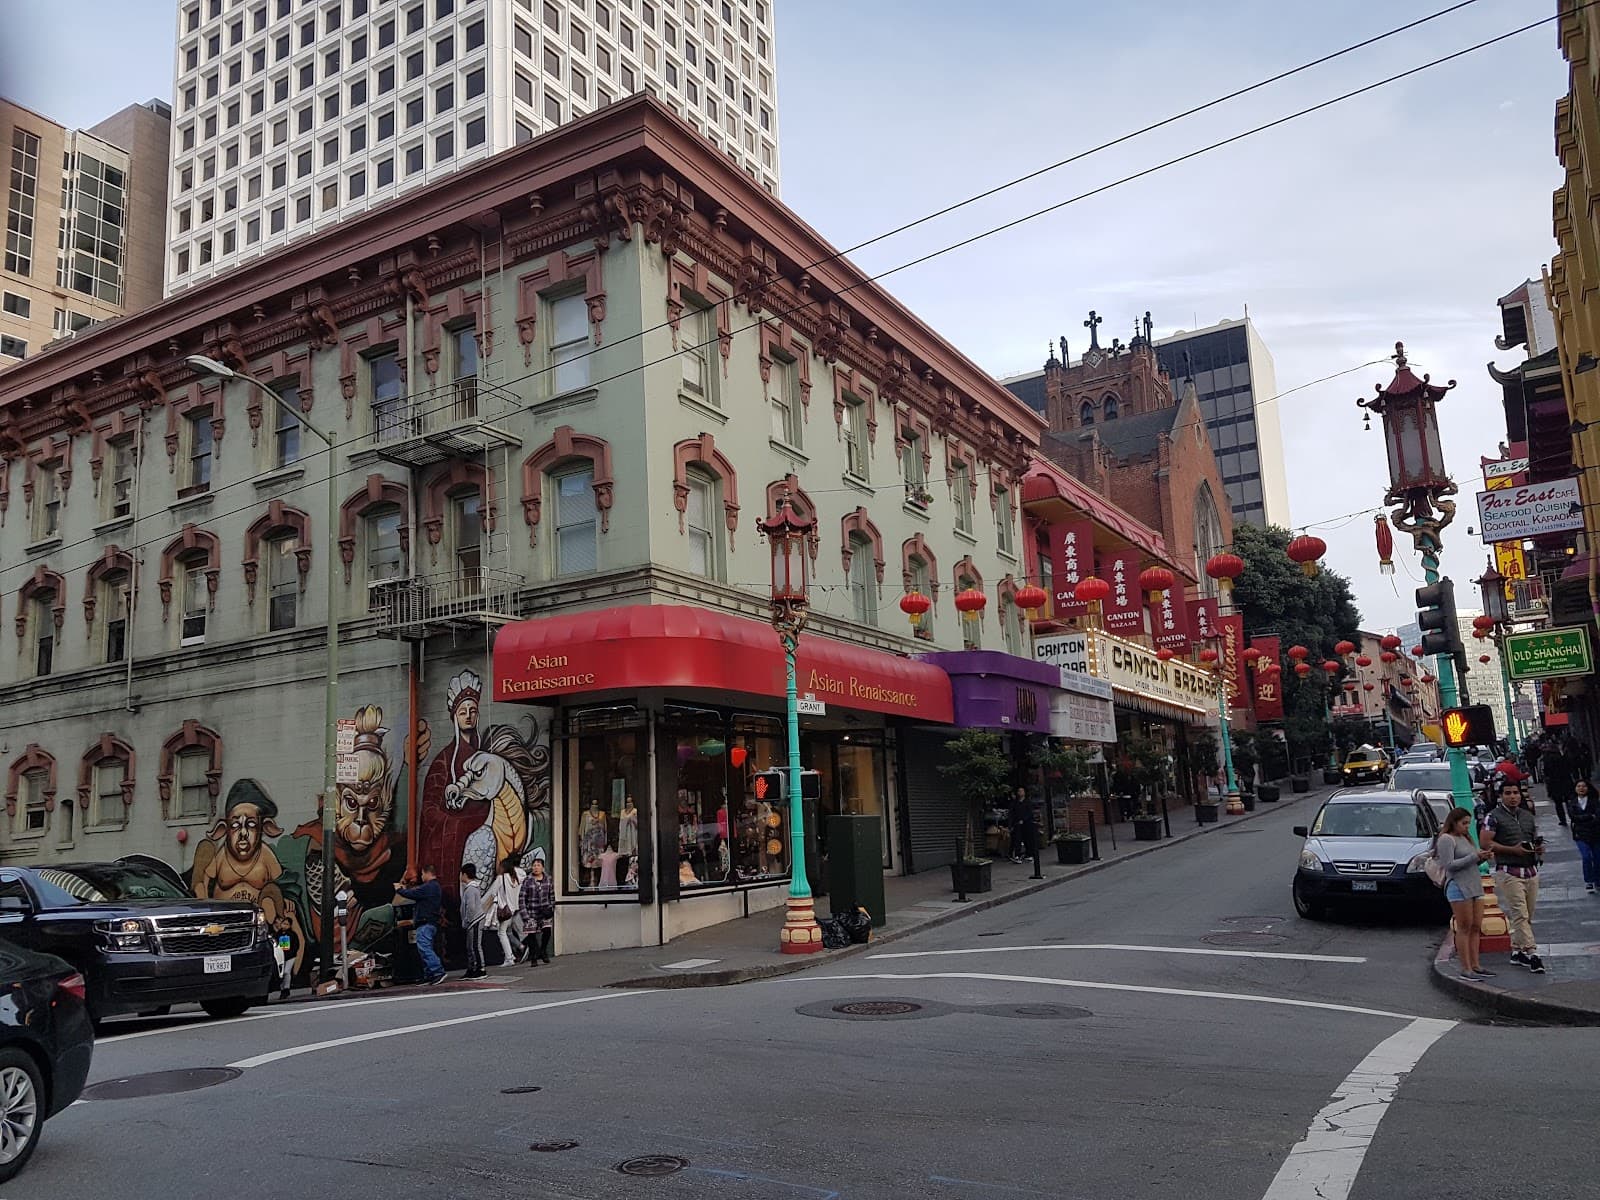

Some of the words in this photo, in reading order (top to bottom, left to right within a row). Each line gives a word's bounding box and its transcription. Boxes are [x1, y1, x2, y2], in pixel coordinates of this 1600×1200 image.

[1481, 493, 1512, 512] Far
[1514, 487, 1555, 507] East
[1107, 611, 1140, 621] CANTON
[1110, 620, 1137, 629] BAZAAR
[1156, 634, 1187, 643] CANTON
[1037, 639, 1085, 657] CANTON
[1513, 650, 1532, 662] OLD
[1533, 644, 1583, 660] SHANGHAI
[527, 655, 568, 670] Asian
[1112, 645, 1169, 683] CANTON
[502, 673, 595, 694] Renaissance
[809, 669, 844, 694] Asian
[849, 677, 917, 706] Renaissance
[800, 701, 820, 712] GRANT
